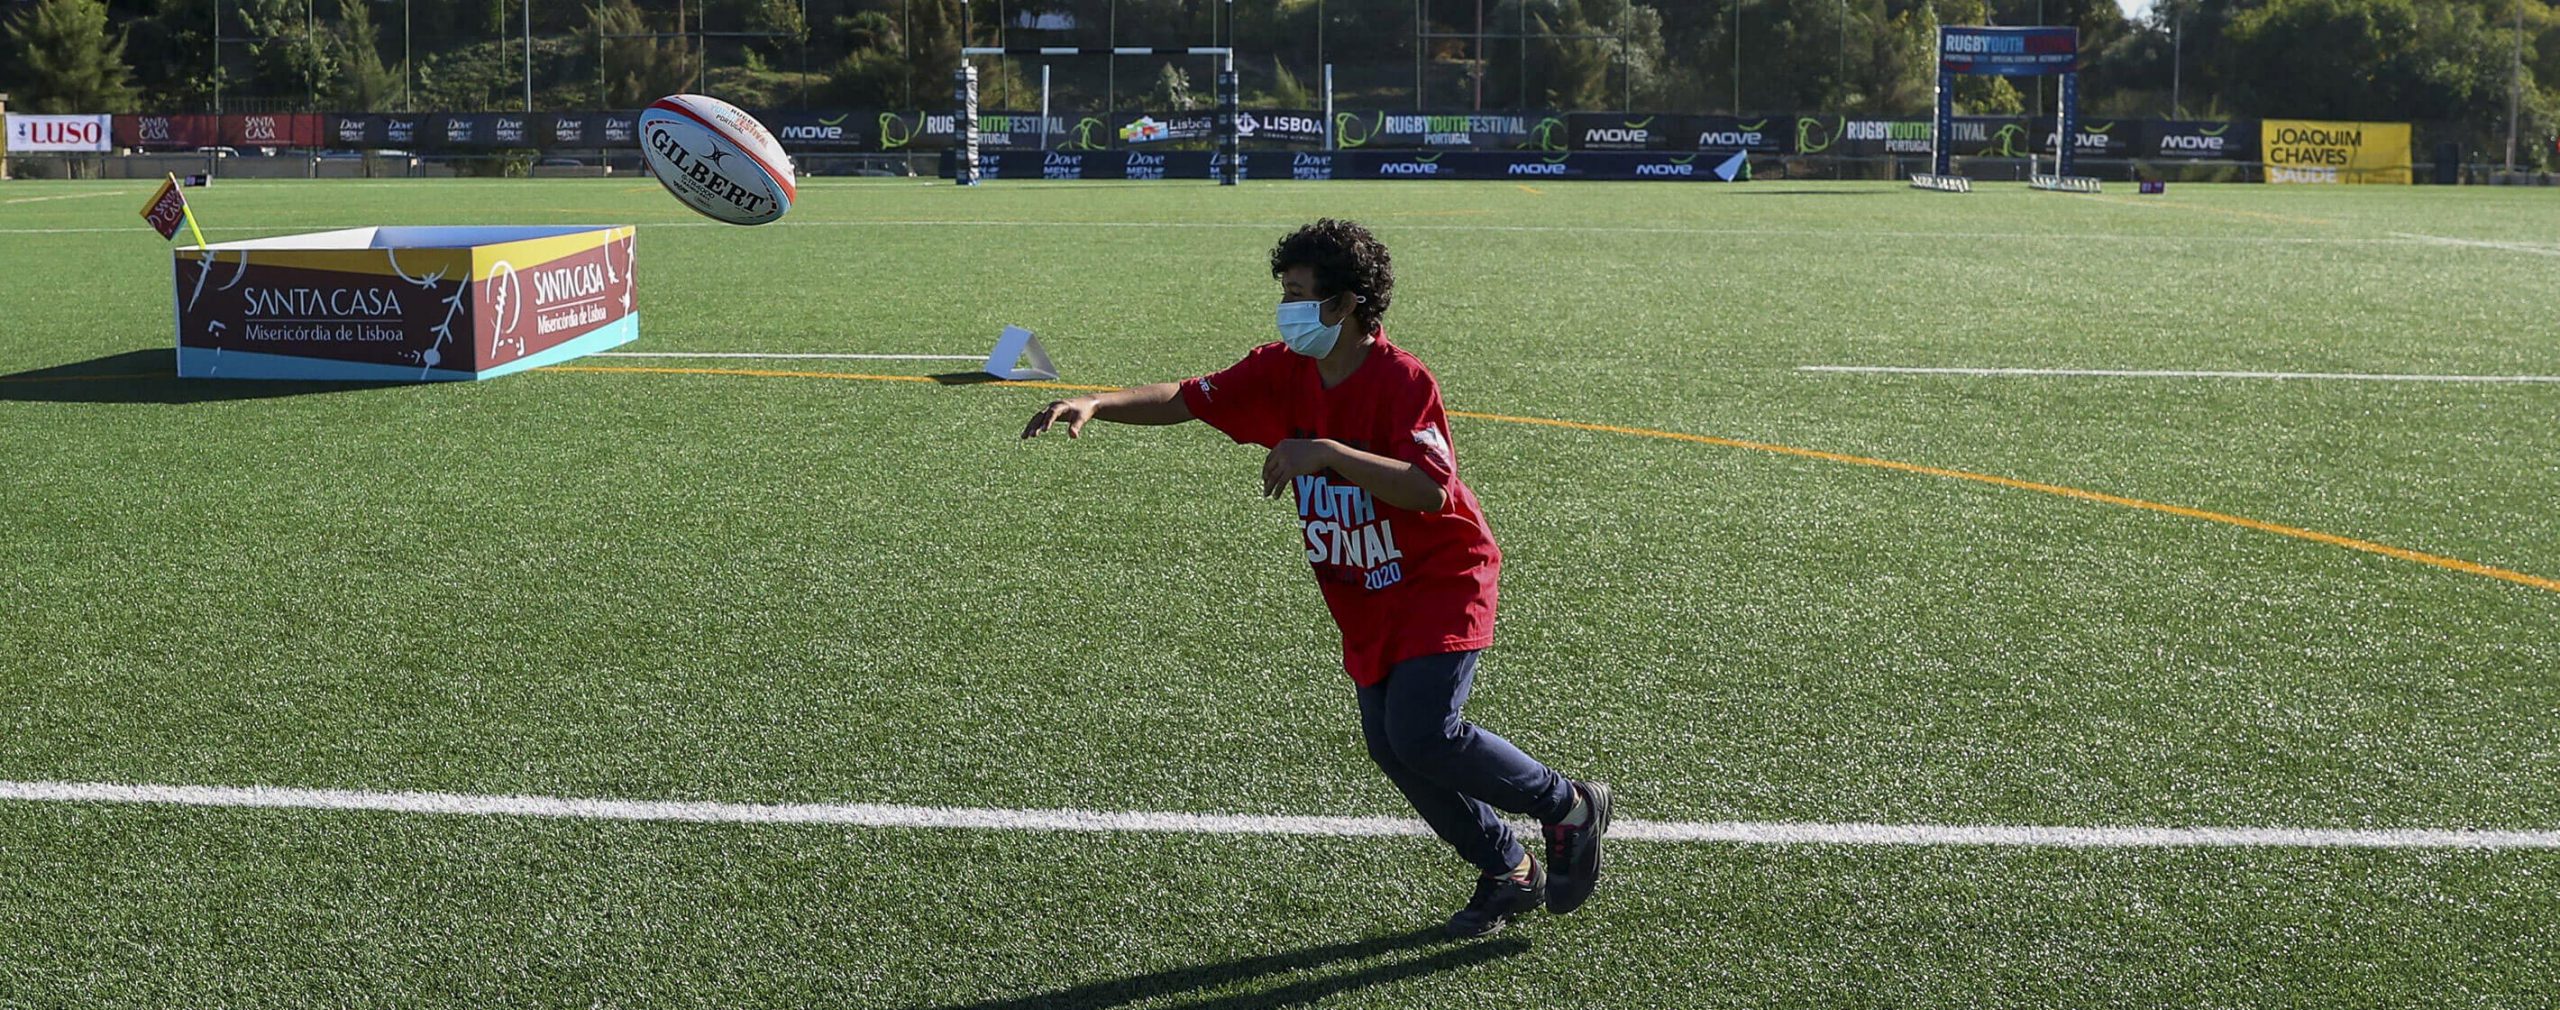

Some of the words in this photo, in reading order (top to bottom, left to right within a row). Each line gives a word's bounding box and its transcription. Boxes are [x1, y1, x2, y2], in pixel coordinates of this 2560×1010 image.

[138, 116, 169, 128] SANTA
[245, 116, 276, 128] SANTA
[1169, 117, 1212, 130] Lisboa
[1264, 116, 1324, 134] LISBOA
[31, 121, 103, 144] LUSO
[138, 127, 169, 139] CASA
[245, 127, 276, 139] CASA
[1424, 133, 1471, 145] PORTUGAL
[2270, 127, 2362, 147] JOAQUIM
[1885, 140, 1932, 153] PORTUGAL
[1043, 151, 1083, 165] Dove
[1126, 152, 1165, 165] Dove
[1293, 152, 1332, 166] Dove
[2270, 147, 2347, 165] CHAVES
[652, 129, 765, 212] GILBERT
[534, 267, 576, 305] SANTA
[574, 263, 605, 298] CASA
[244, 287, 327, 316] SANTA
[331, 288, 403, 316] CASA
[579, 307, 587, 325] de
[587, 305, 607, 324] Lisboa
[245, 324, 331, 341] Misericórdia
[335, 324, 353, 341] de
[358, 324, 404, 342] Lisboa
[1363, 561, 1402, 590] 2020
